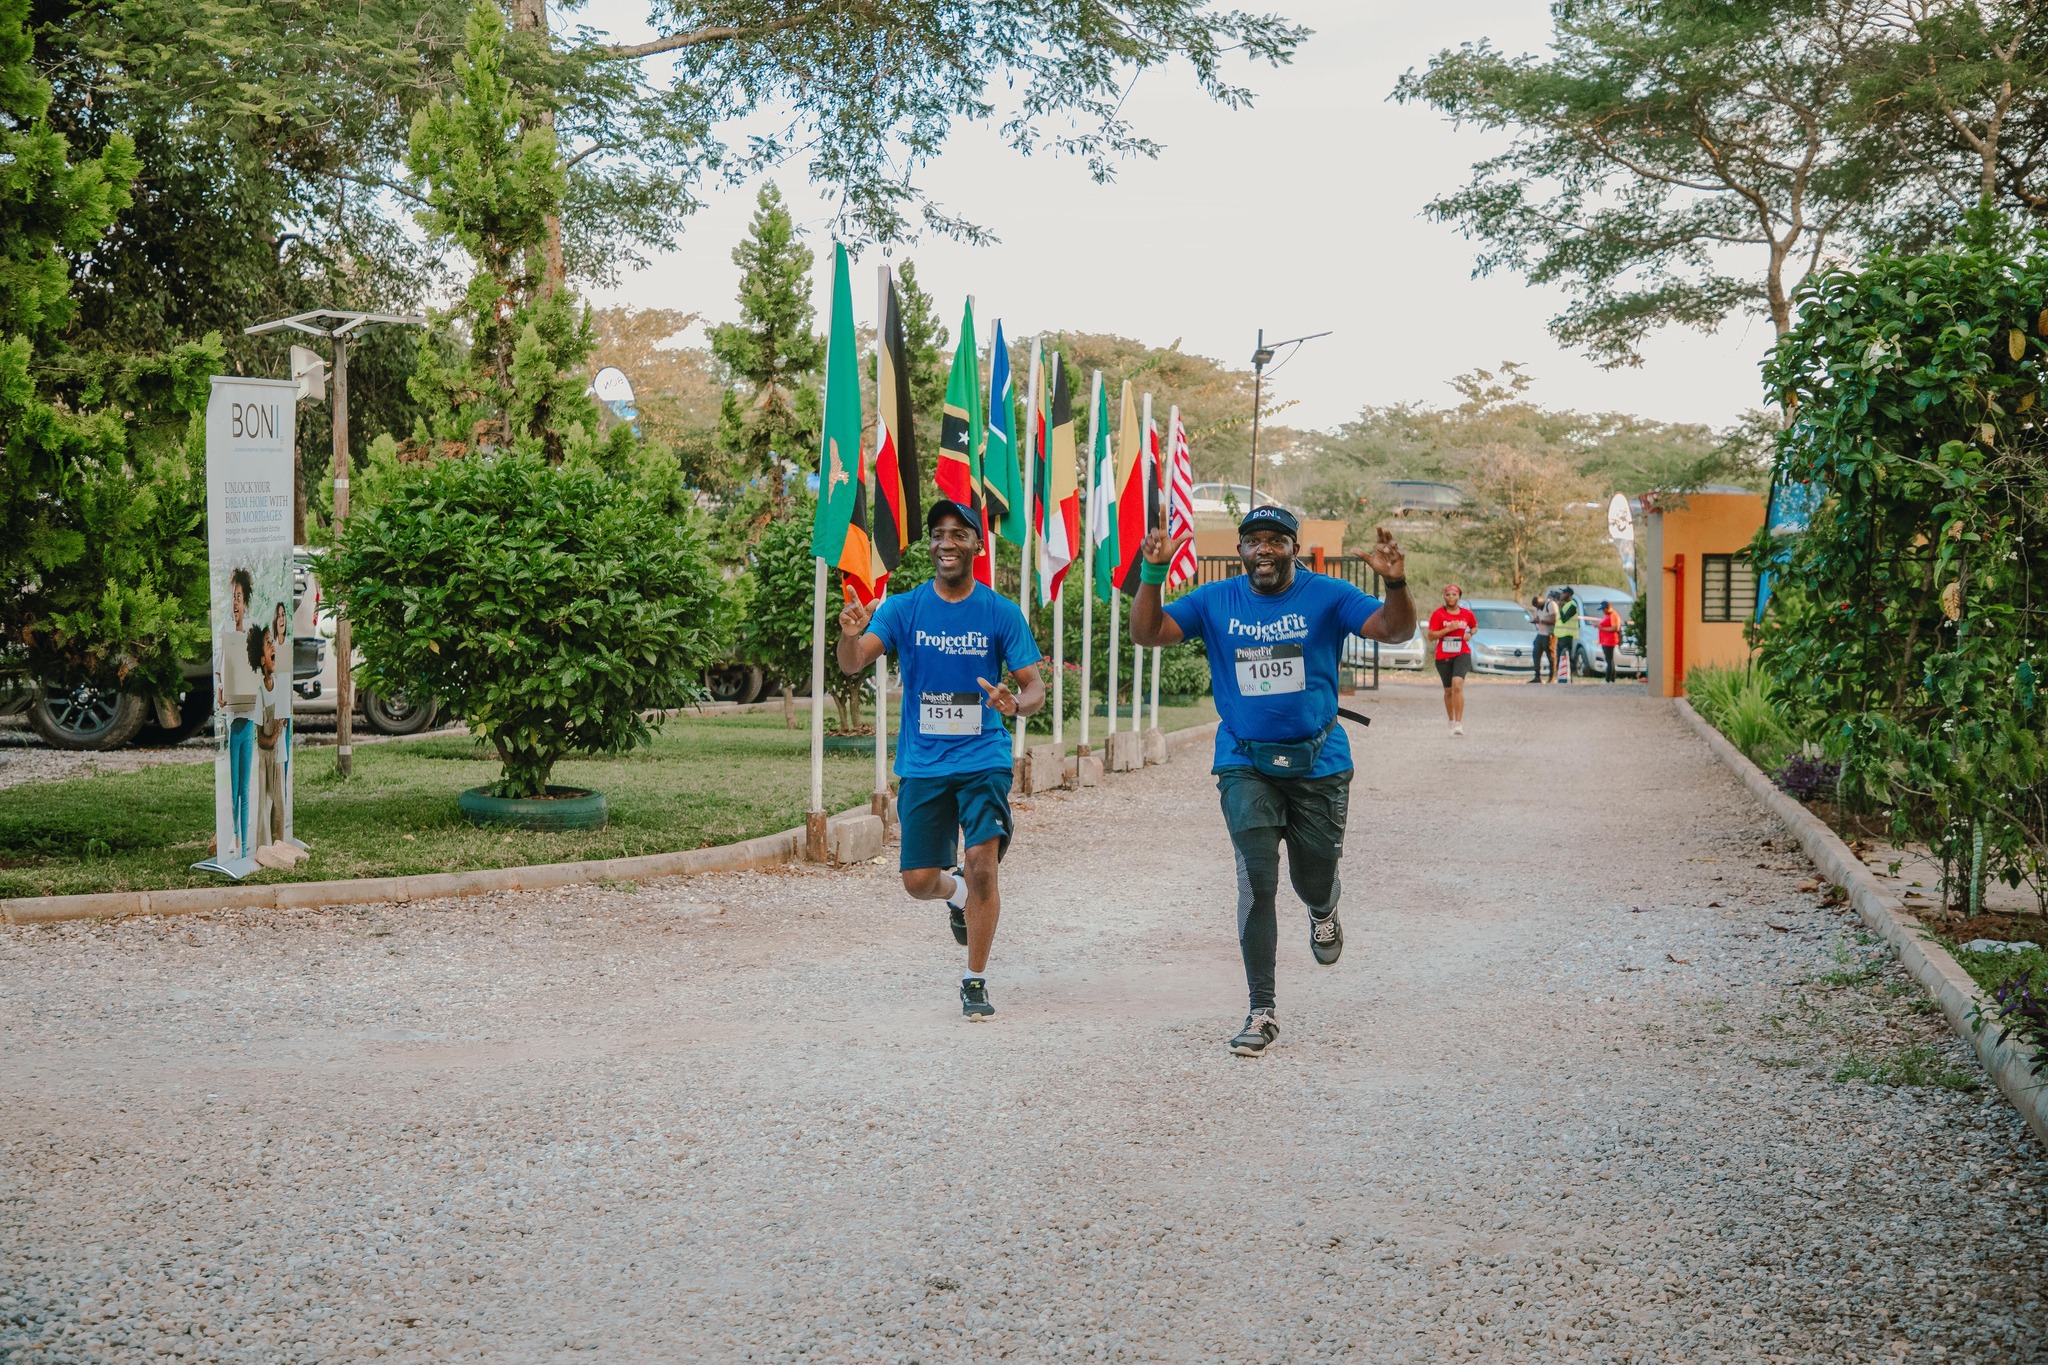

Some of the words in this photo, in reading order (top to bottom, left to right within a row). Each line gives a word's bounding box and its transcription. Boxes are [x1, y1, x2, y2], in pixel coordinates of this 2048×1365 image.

[232, 402, 279, 438] BONI
[224, 482, 253, 494] UNLOCK
[254, 482, 270, 493] YOUR
[225, 496, 248, 508] DREAM
[249, 496, 268, 508] HOME
[269, 495, 288, 507] WITH
[226, 512, 241, 524] BONI
[242, 510, 282, 522] MORTGAGES
[1228, 613, 1307, 640] ProjectFit
[915, 630, 989, 651] ProjectFit
[1262, 634, 1275, 642] The
[1275, 628, 1309, 641] Challenge
[945, 646, 957, 655] The
[958, 647, 988, 657] Challenge
[1249, 661, 1293, 679] 1095
[927, 707, 964, 719] 1514
